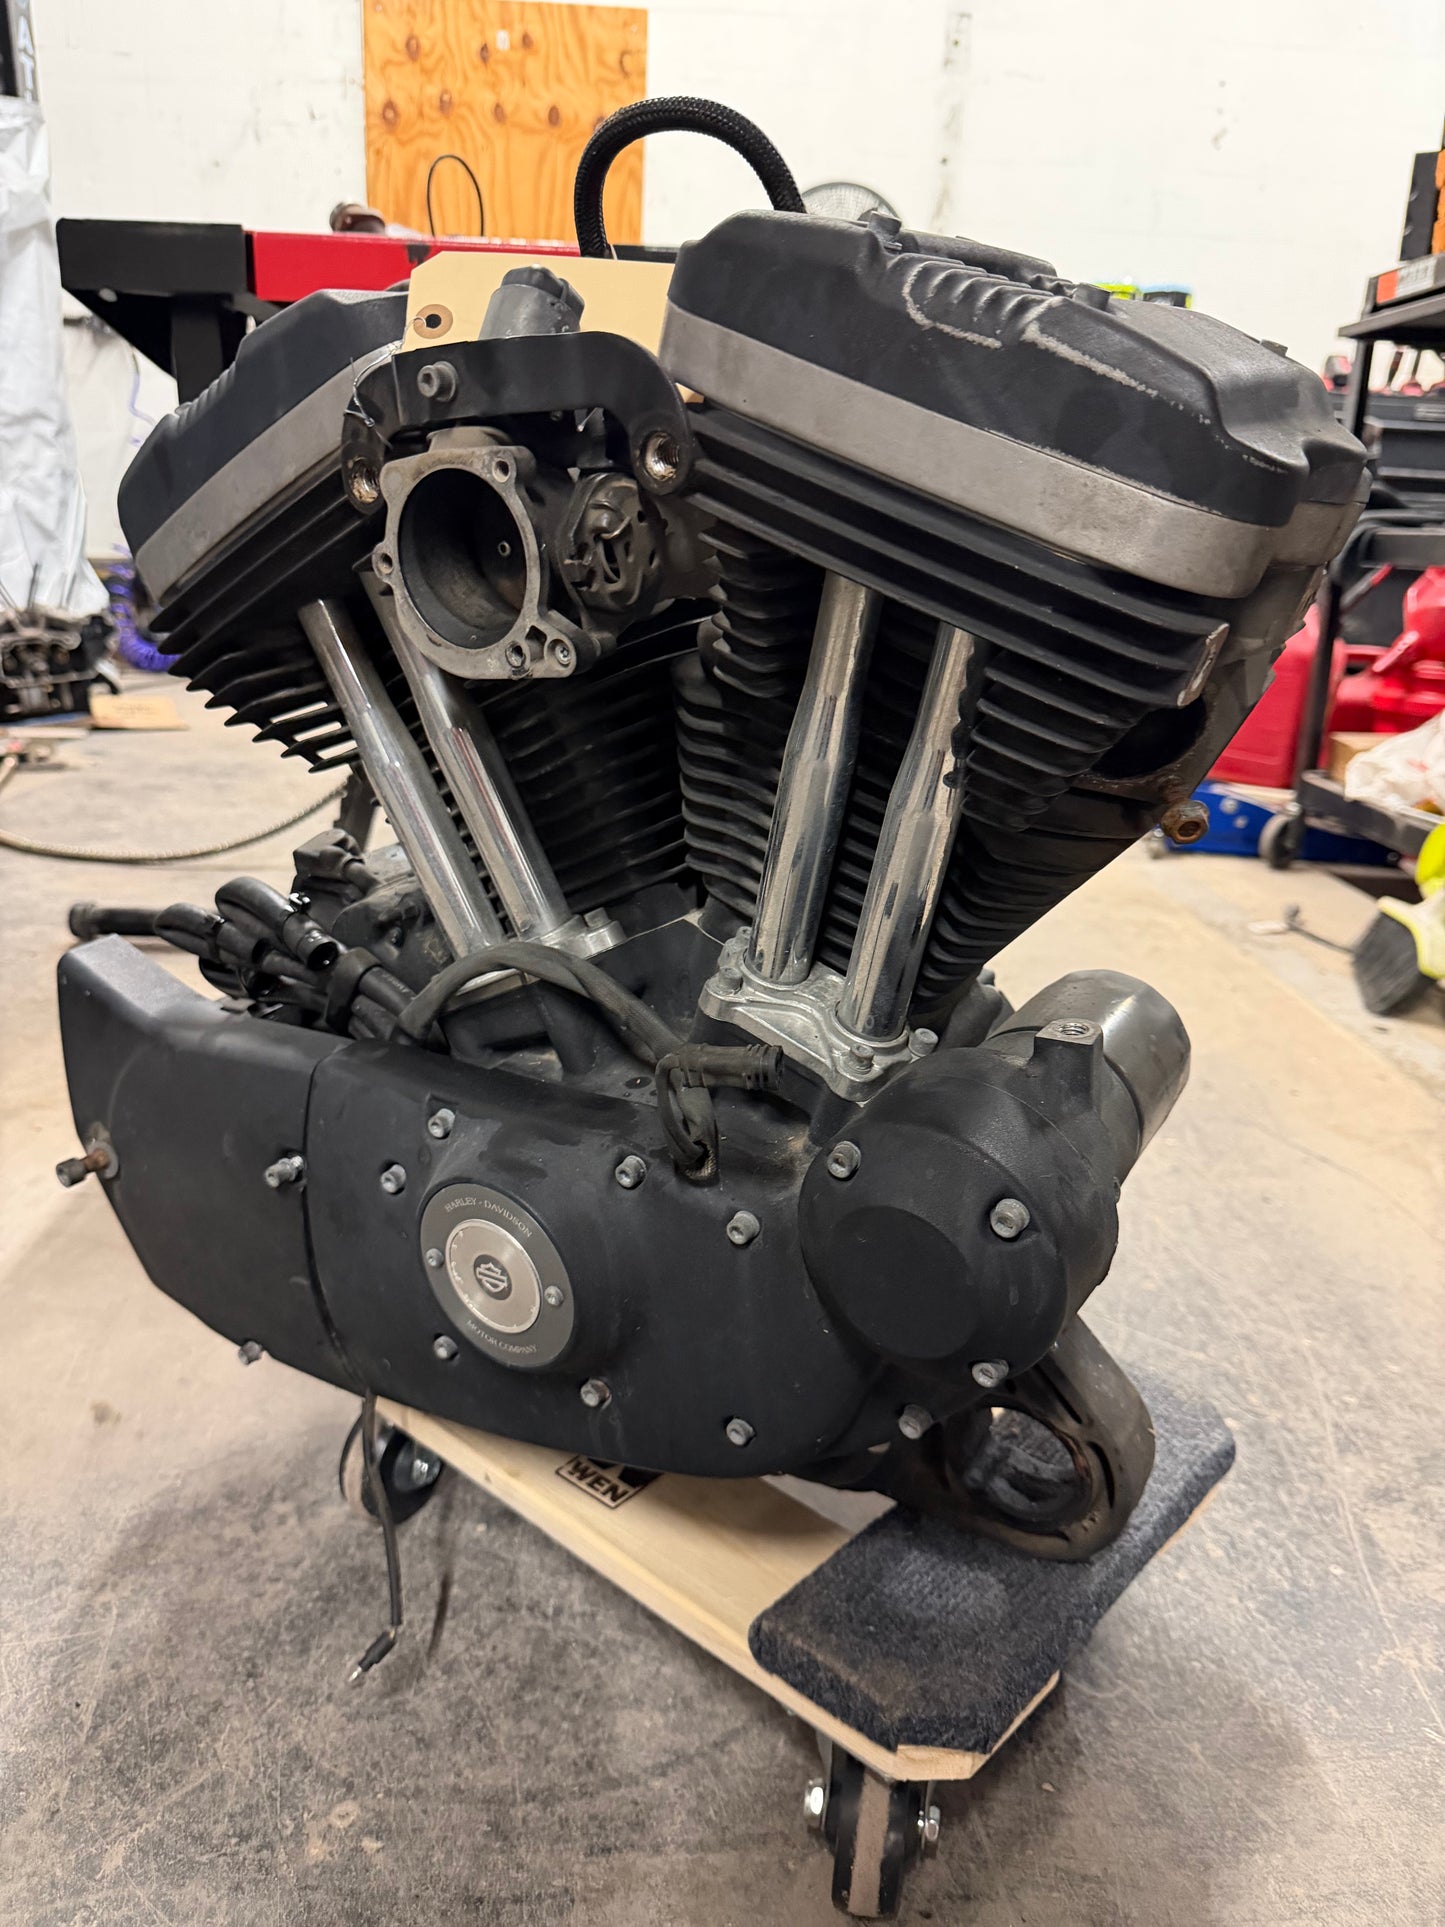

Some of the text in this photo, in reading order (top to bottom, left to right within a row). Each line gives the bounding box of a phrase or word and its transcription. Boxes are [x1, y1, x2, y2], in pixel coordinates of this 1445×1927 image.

[466, 1319, 537, 1354] MOTOR COMPANY
[568, 1460, 629, 1502] WEN
